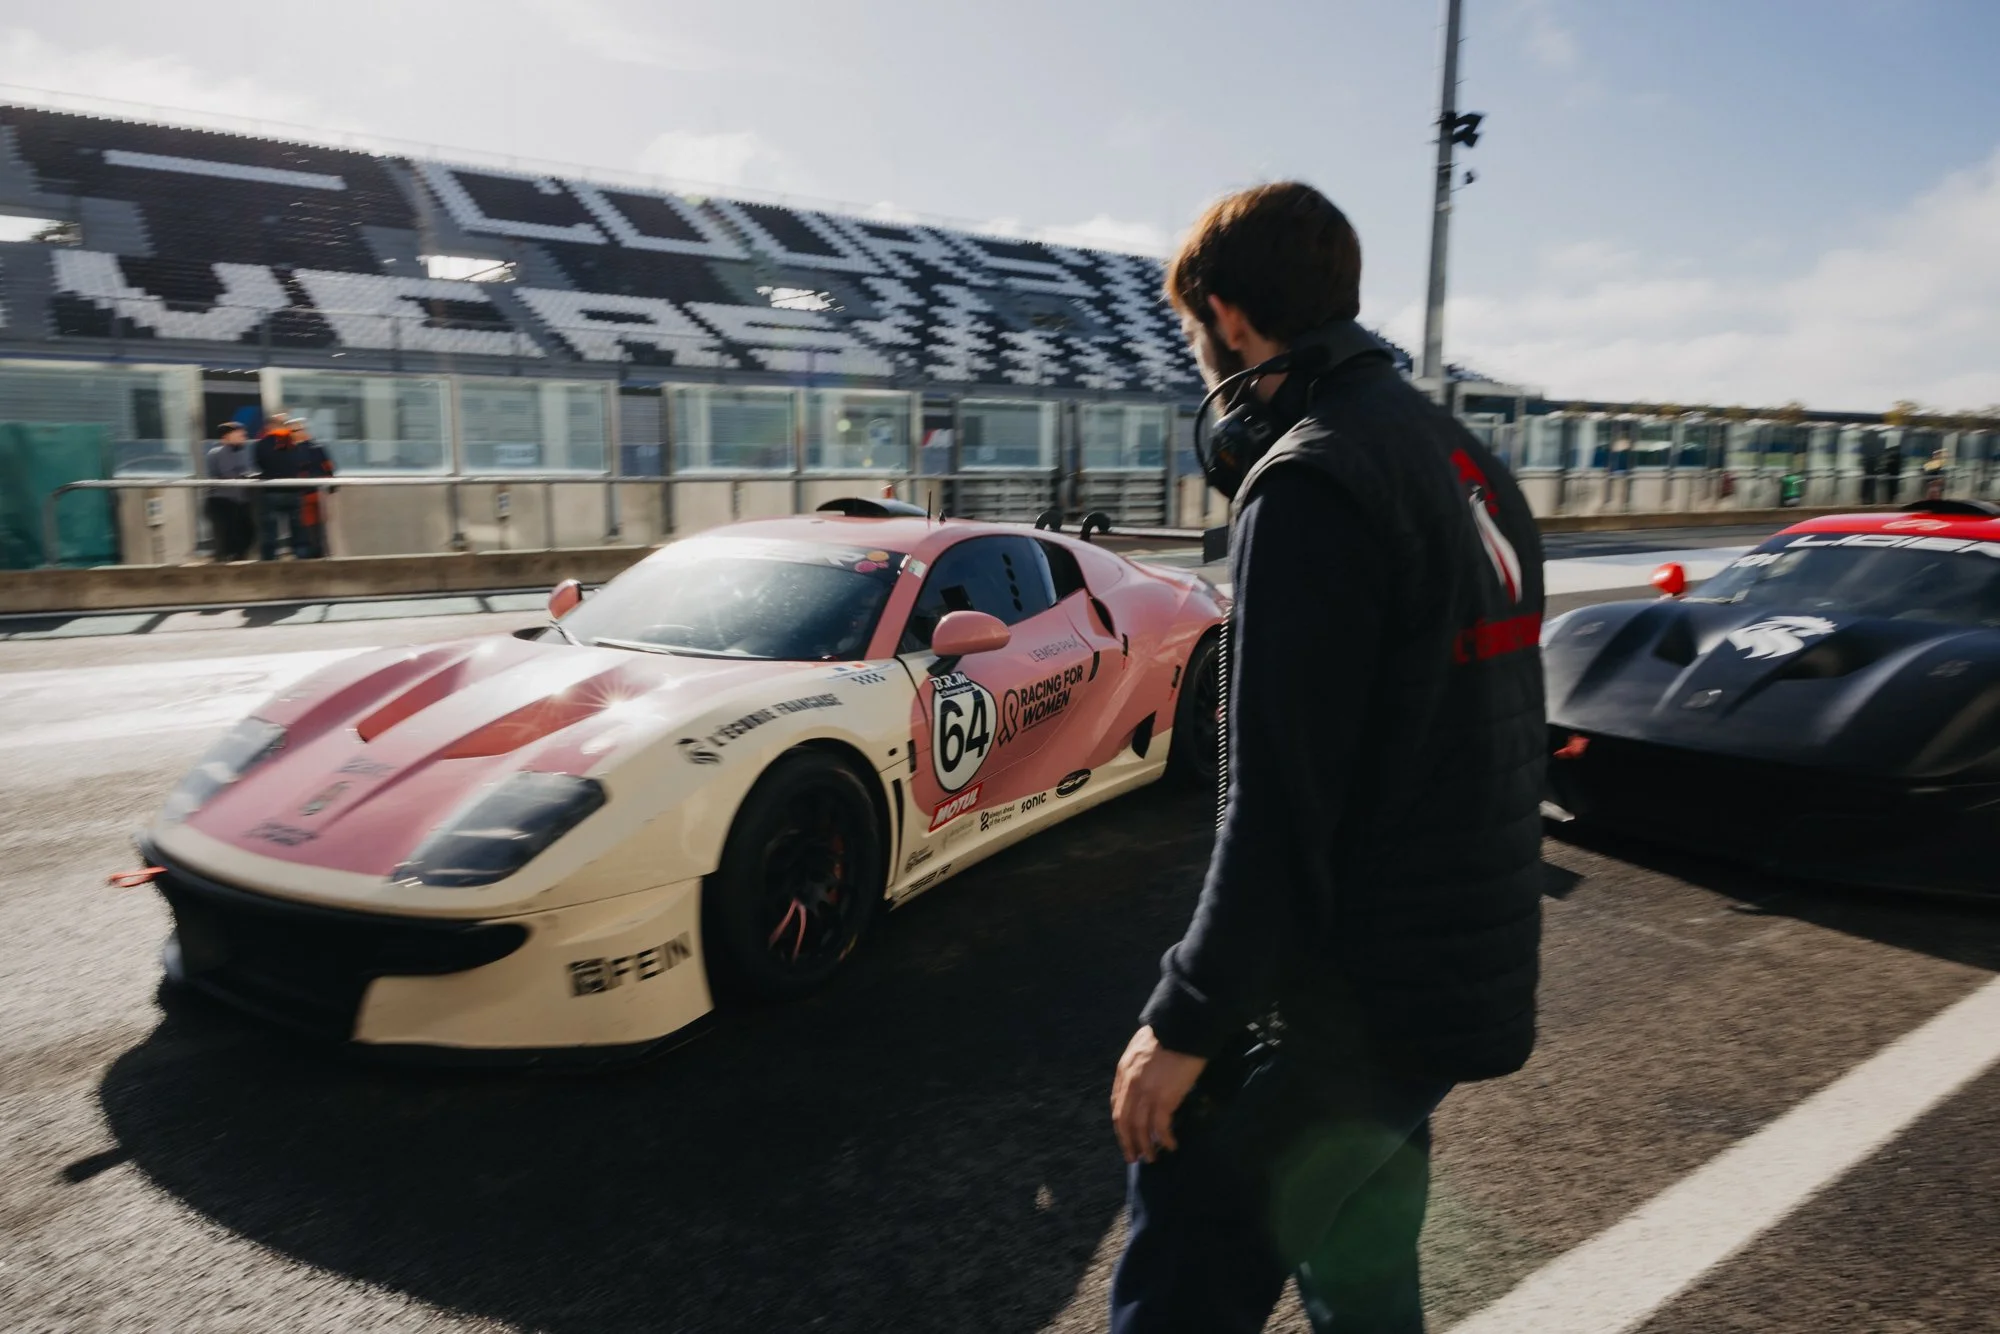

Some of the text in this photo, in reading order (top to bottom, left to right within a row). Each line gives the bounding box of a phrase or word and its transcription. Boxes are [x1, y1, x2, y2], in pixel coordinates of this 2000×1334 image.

[0, 248, 896, 377] VERS
[1020, 664, 1083, 707] RACING FOR
[1023, 687, 1071, 728] WOMEN
[940, 690, 989, 773] 64
[931, 787, 980, 828] MOTUL
[1003, 804, 1015, 815] ahead
[1021, 792, 1047, 813] SONIC
